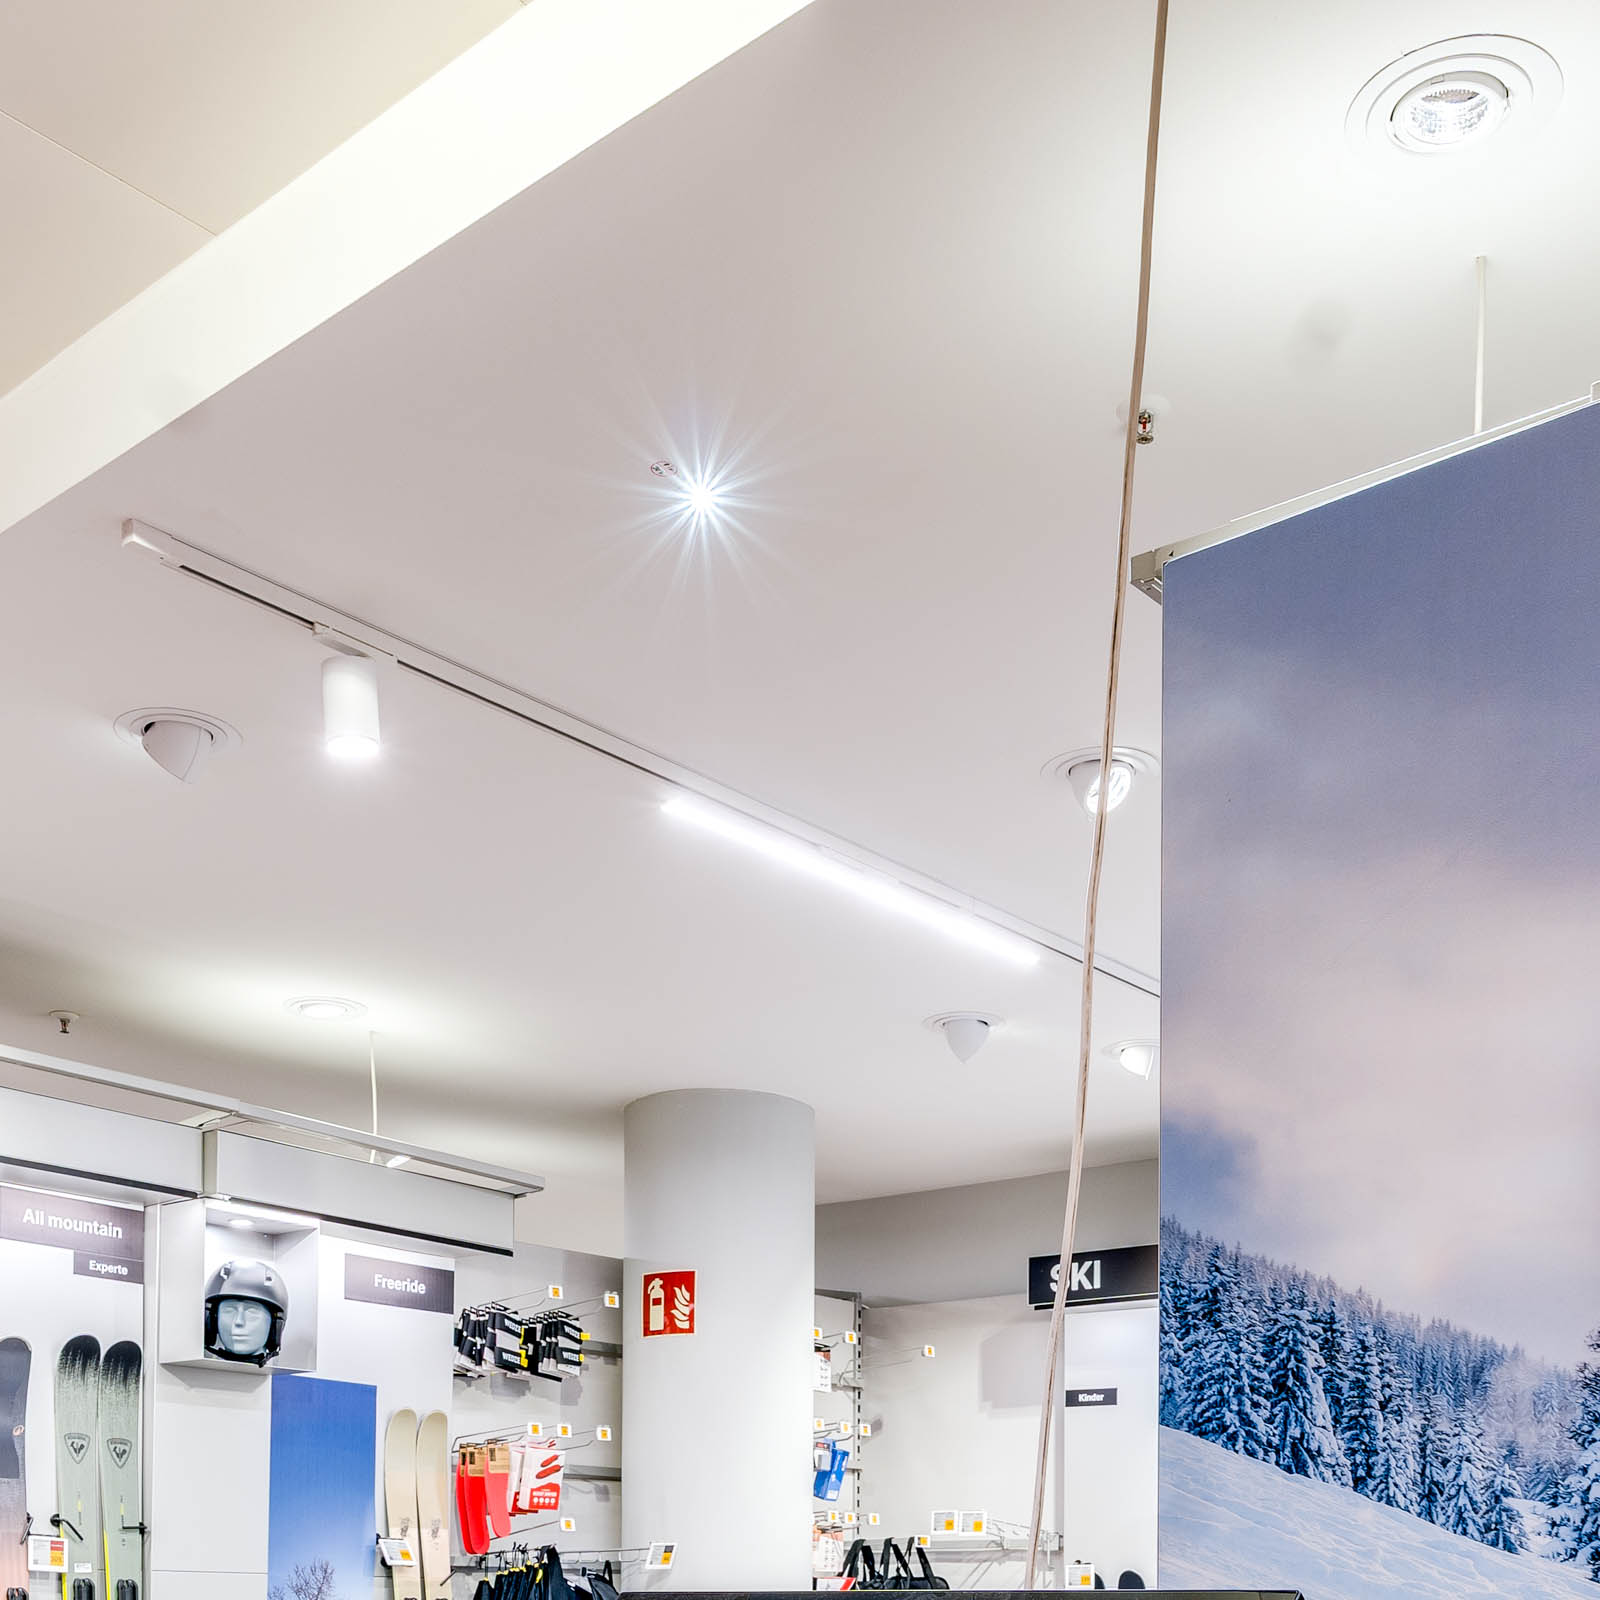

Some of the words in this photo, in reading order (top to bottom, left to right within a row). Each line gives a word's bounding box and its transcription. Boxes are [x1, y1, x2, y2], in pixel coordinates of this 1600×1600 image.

[22, 1209, 45, 1228] All
[48, 1212, 123, 1239] mountain
[89, 1260, 128, 1276] Experte
[374, 1274, 426, 1295] Freeride
[1078, 1393, 1104, 1403] Kinder
